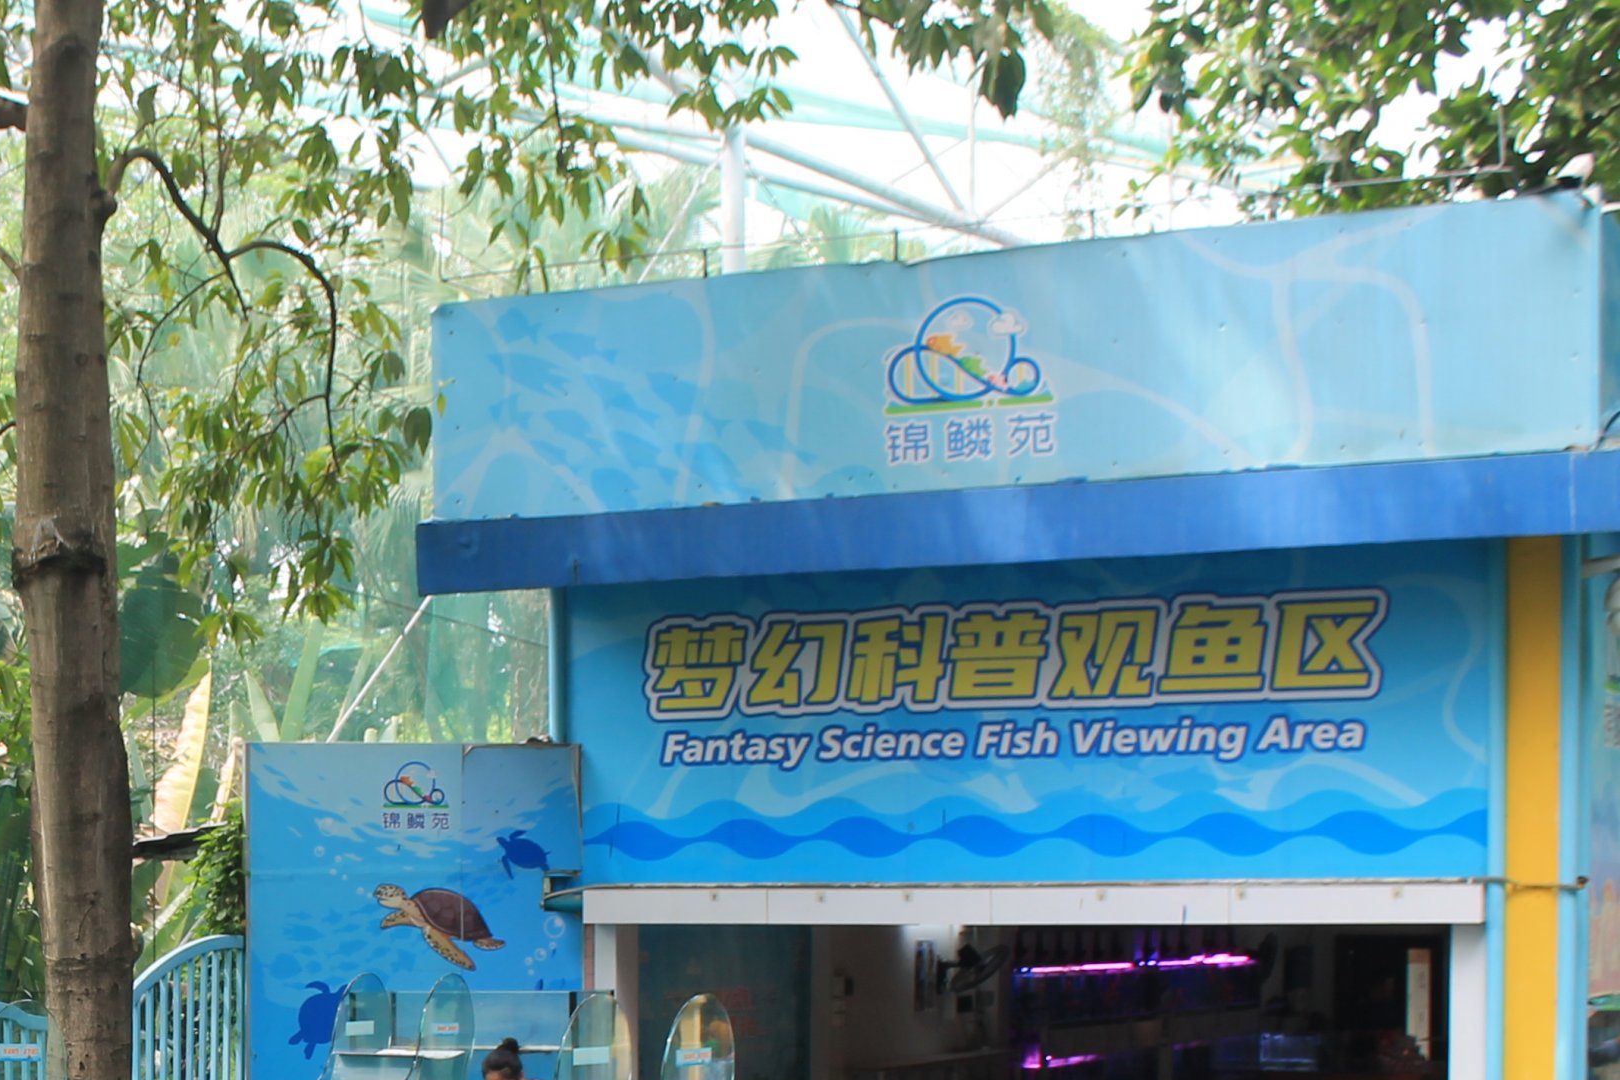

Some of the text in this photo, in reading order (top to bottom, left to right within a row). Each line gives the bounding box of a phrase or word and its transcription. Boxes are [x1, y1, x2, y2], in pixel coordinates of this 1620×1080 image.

[885, 413, 1055, 464] 锦鳞苑
[653, 600, 1378, 712] 梦幻科普观鱼区
[662, 716, 1365, 768] Fantasy Science Fish Viewing Area
